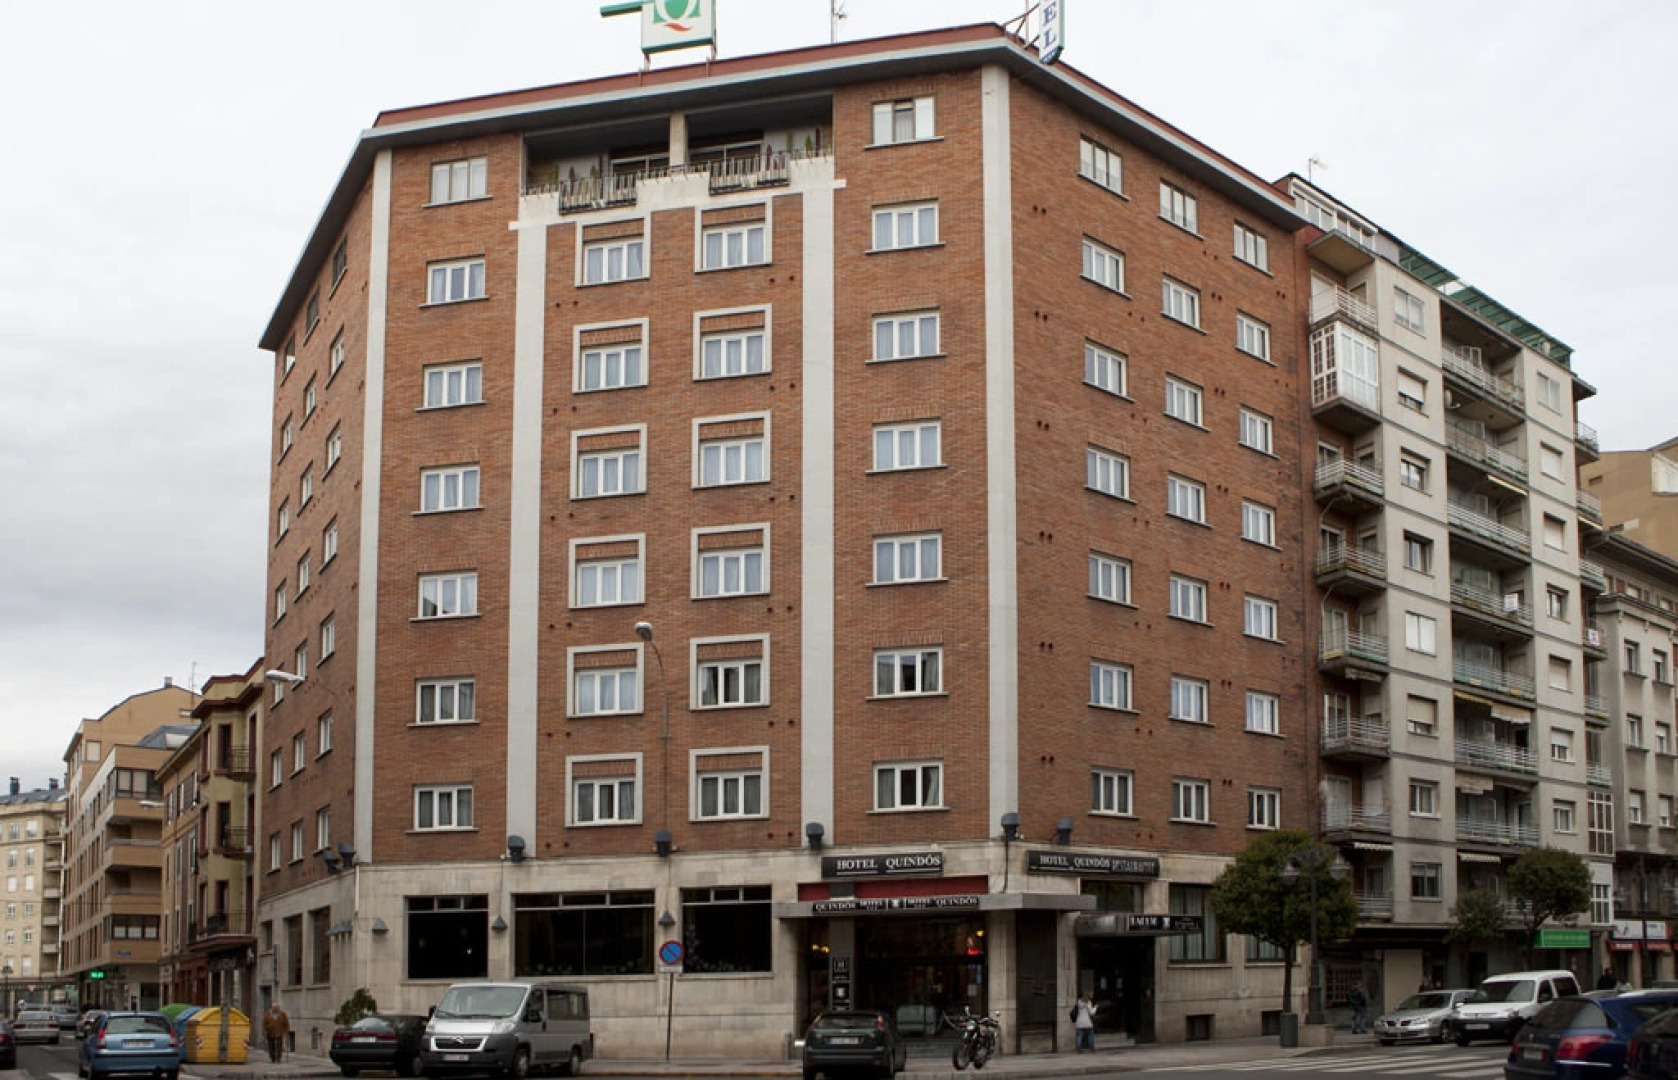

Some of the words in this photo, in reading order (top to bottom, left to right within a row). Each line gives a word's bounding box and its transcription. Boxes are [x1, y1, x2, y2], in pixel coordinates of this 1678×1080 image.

[837, 858, 877, 870] HOTEL
[886, 854, 940, 869] QUINDÓS
[1040, 855, 1069, 866] HOTEL
